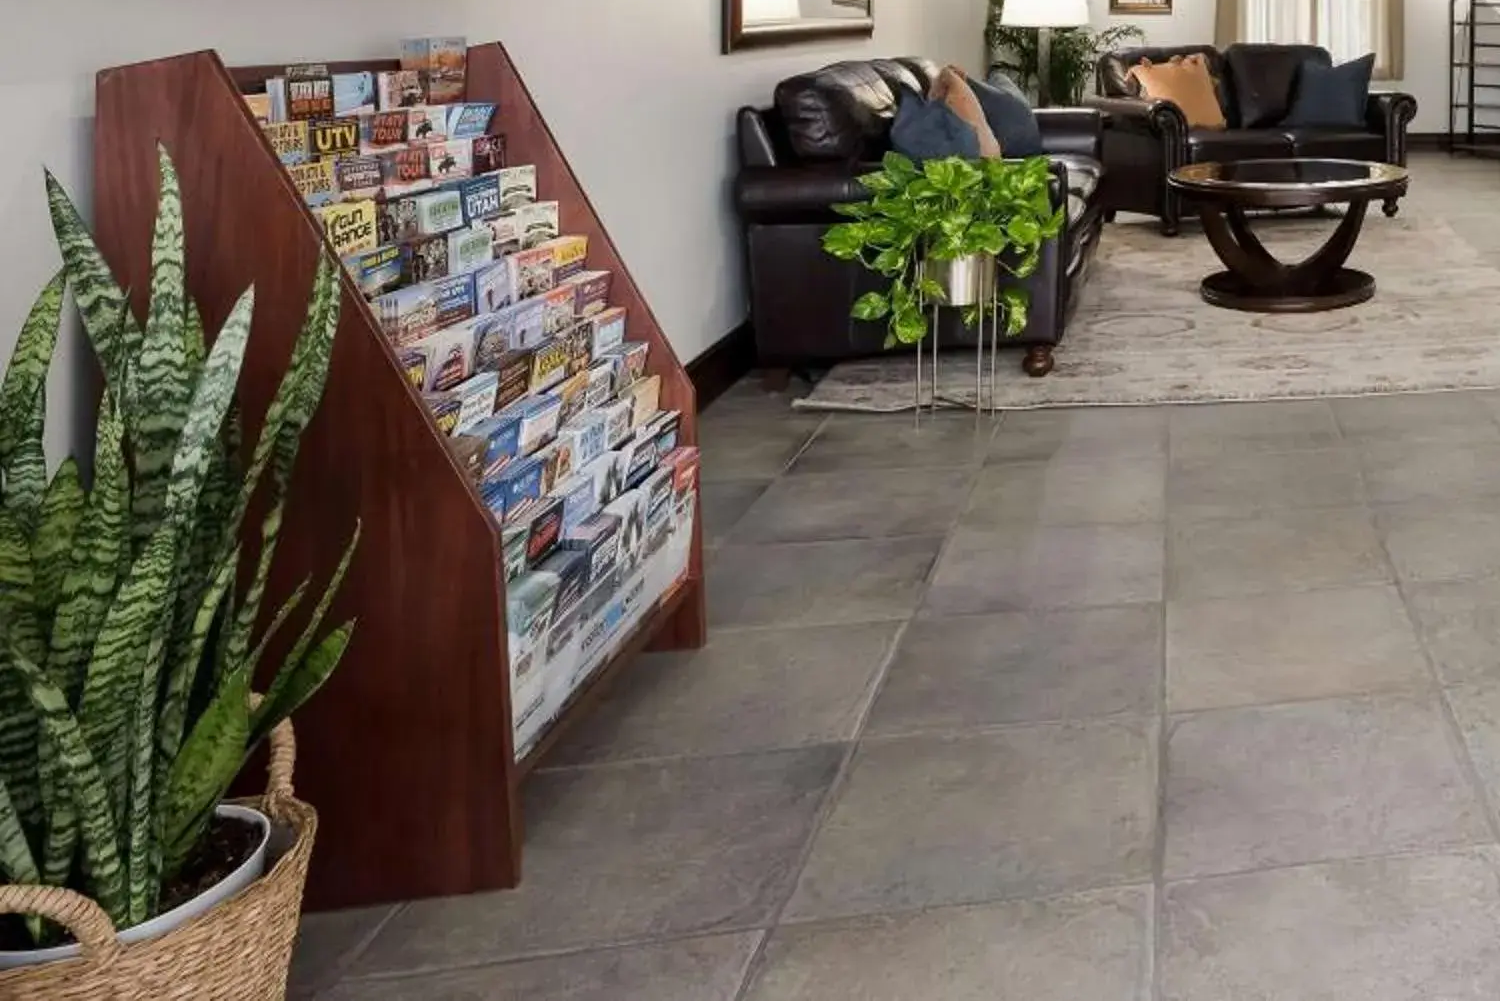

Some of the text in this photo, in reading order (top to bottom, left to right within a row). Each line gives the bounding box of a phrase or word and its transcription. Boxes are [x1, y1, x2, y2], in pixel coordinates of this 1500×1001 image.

[316, 124, 357, 151] UTV
[467, 194, 499, 218] UTAH
[339, 208, 363, 229] GUN
